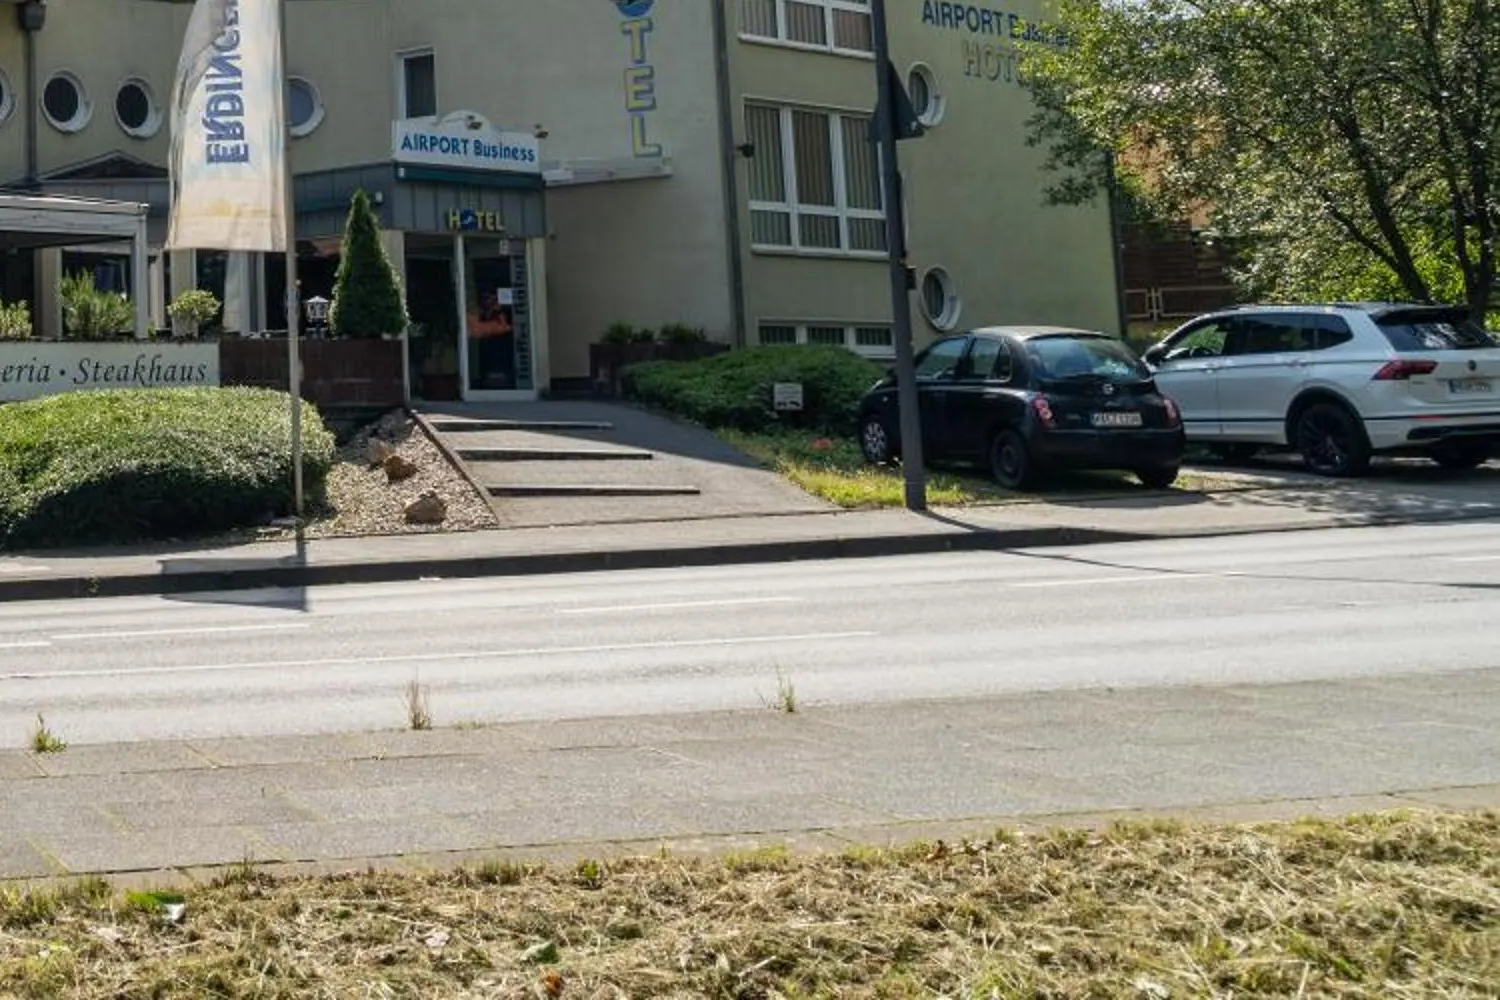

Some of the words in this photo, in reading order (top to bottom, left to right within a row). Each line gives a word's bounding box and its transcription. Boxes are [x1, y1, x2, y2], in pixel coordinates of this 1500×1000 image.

[401, 132, 470, 156] AIRPORT
[473, 139, 536, 163] Business
[73, 353, 207, 388] Steakhaus
